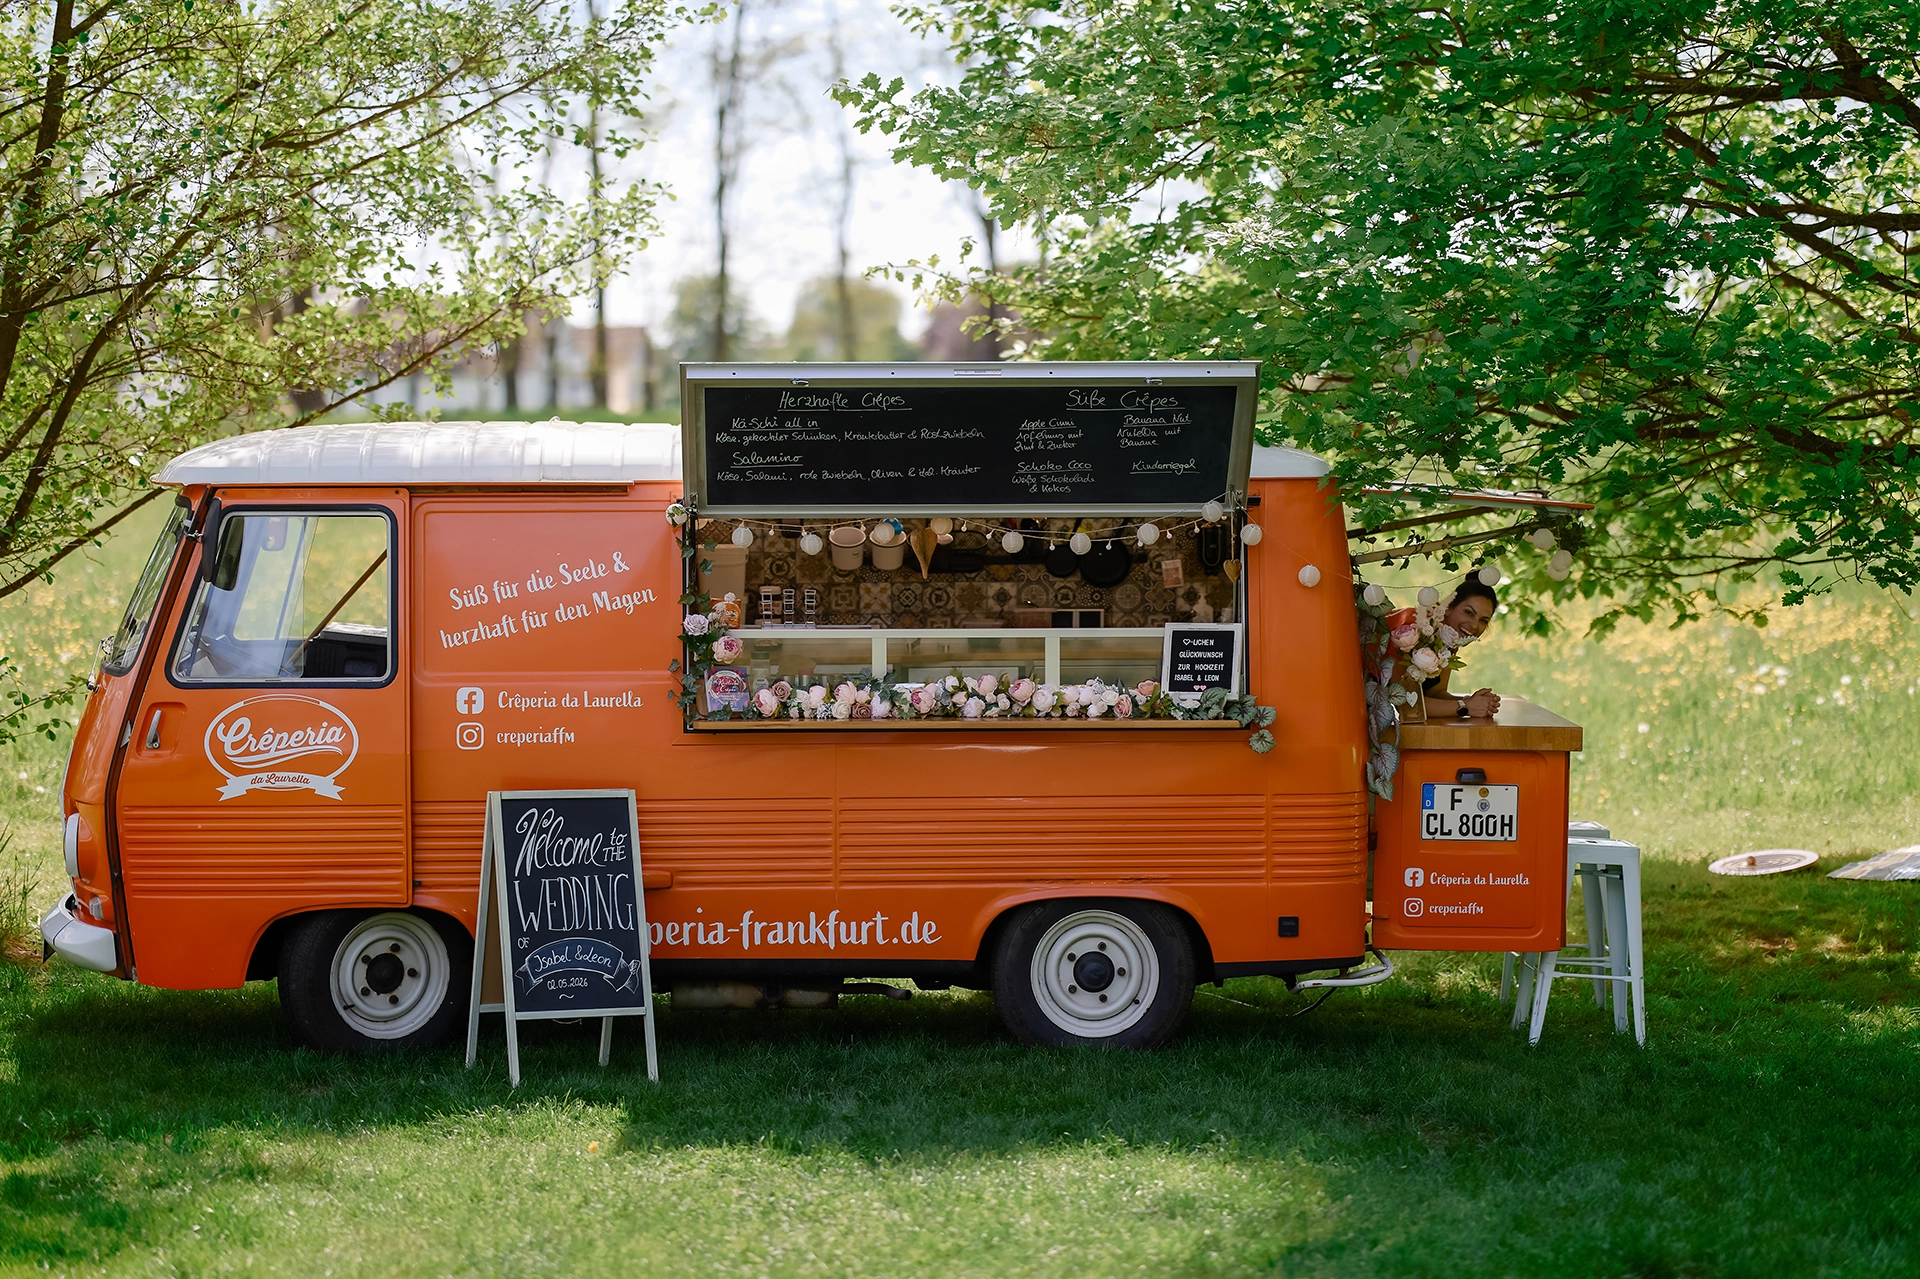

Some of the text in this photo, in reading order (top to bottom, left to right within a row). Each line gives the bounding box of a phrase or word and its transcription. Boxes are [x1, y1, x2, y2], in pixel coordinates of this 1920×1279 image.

[778, 390, 906, 411] Herzhafte Crêpes
[1066, 389, 1179, 414] Süße Crêpes
[732, 416, 819, 429] Kä-Schi all in
[1021, 419, 1046, 431] Apple
[1123, 413, 1192, 425] Banana Nut
[907, 429, 918, 439] &
[920, 428, 986, 440] Röstzwiebeln
[1015, 428, 1084, 442] Apfelmus mit
[1116, 426, 1181, 438] Nutella mit
[1037, 440, 1045, 450] &
[1046, 440, 1078, 451] Zucker
[1119, 437, 1160, 449] Banane
[732, 451, 803, 466] Salamino
[1017, 459, 1092, 472] Schoko Coco
[799, 470, 818, 480] rote
[907, 467, 916, 477] &
[940, 464, 981, 476] Kräuter
[1132, 457, 1197, 476] Kinderriegel
[1011, 473, 1096, 486] Weiße Schokolade
[1028, 484, 1072, 493] & Kokos
[449, 551, 630, 611] Süß für die Seele &
[439, 588, 658, 649] herzhaft für den Magen
[1178, 650, 1224, 658] GLÜCKWUNSCH
[1177, 663, 1225, 671] ZUR HOCHZEIT
[1174, 674, 1220, 682] ISABEL & LEON
[498, 690, 643, 712] Crêperia da Laurella
[216, 717, 347, 755] Crêperia
[250, 773, 310, 785] da Laurella
[1451, 788, 1464, 811] F
[1426, 813, 1513, 837] CL 800H
[514, 807, 628, 877] Welcome to
[602, 845, 627, 862] THE
[1429, 872, 1530, 887] Crêperia da Laurella
[513, 873, 635, 932] WEDDING
[517, 936, 530, 950] OF
[534, 946, 571, 973] Isabel
[546, 977, 588, 991] 02.05.2026
